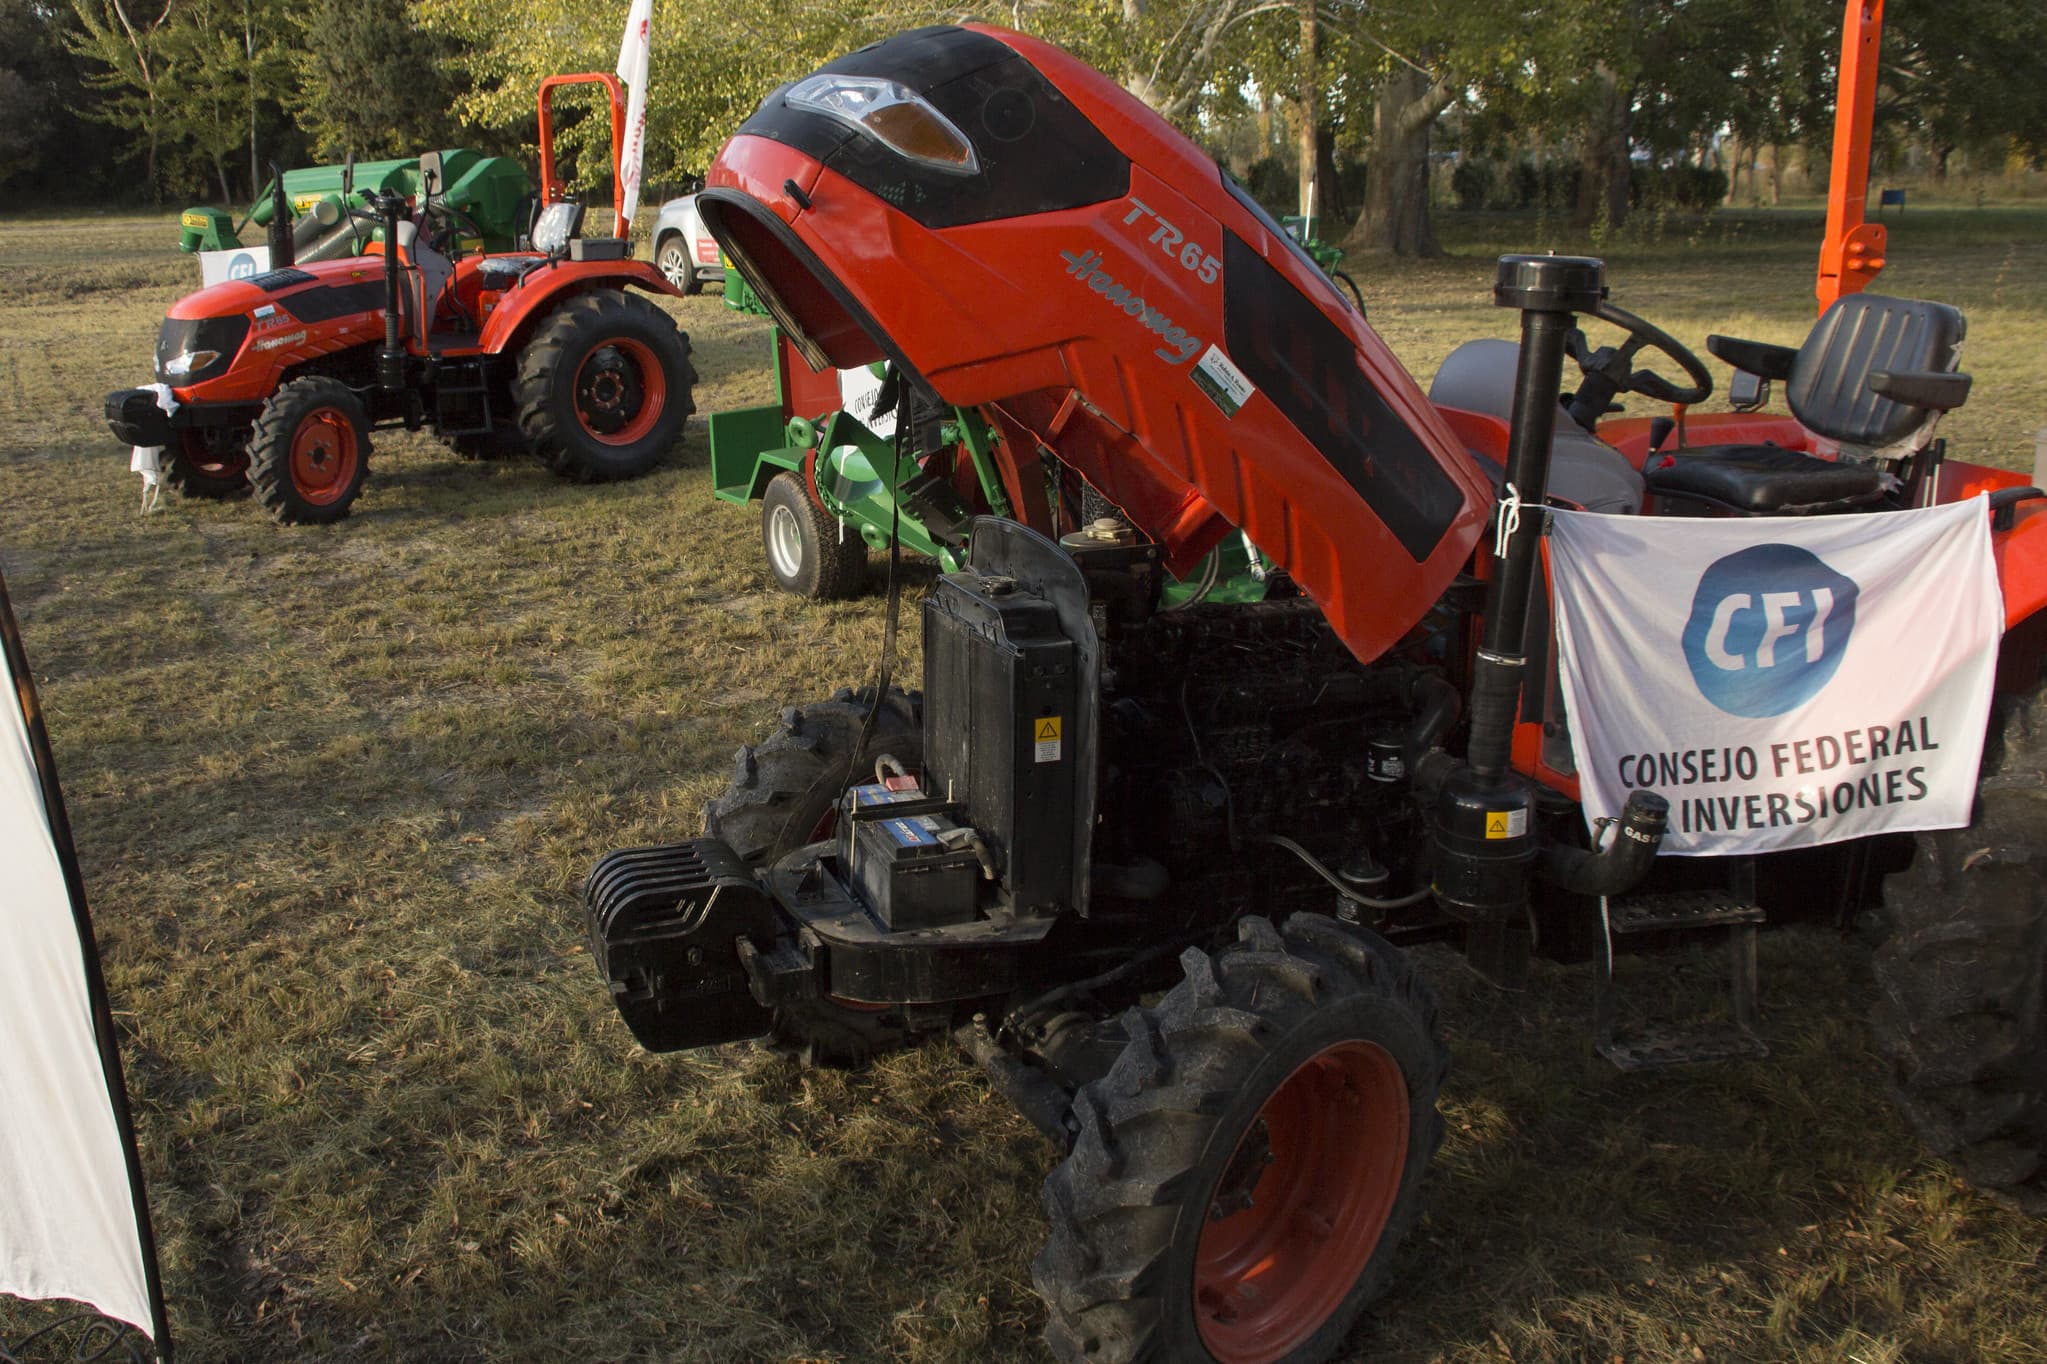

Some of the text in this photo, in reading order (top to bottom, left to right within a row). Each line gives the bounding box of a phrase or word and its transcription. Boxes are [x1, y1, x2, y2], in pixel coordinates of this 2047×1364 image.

[1123, 196, 1222, 284] TR65
[1060, 249, 1202, 365] Hanomag
[1704, 587, 1834, 671] CFI
[1618, 716, 1939, 788] CONSEJO FEDERAL
[1624, 826, 1651, 843] GAS
[1681, 766, 1929, 833] INVERSIONES
